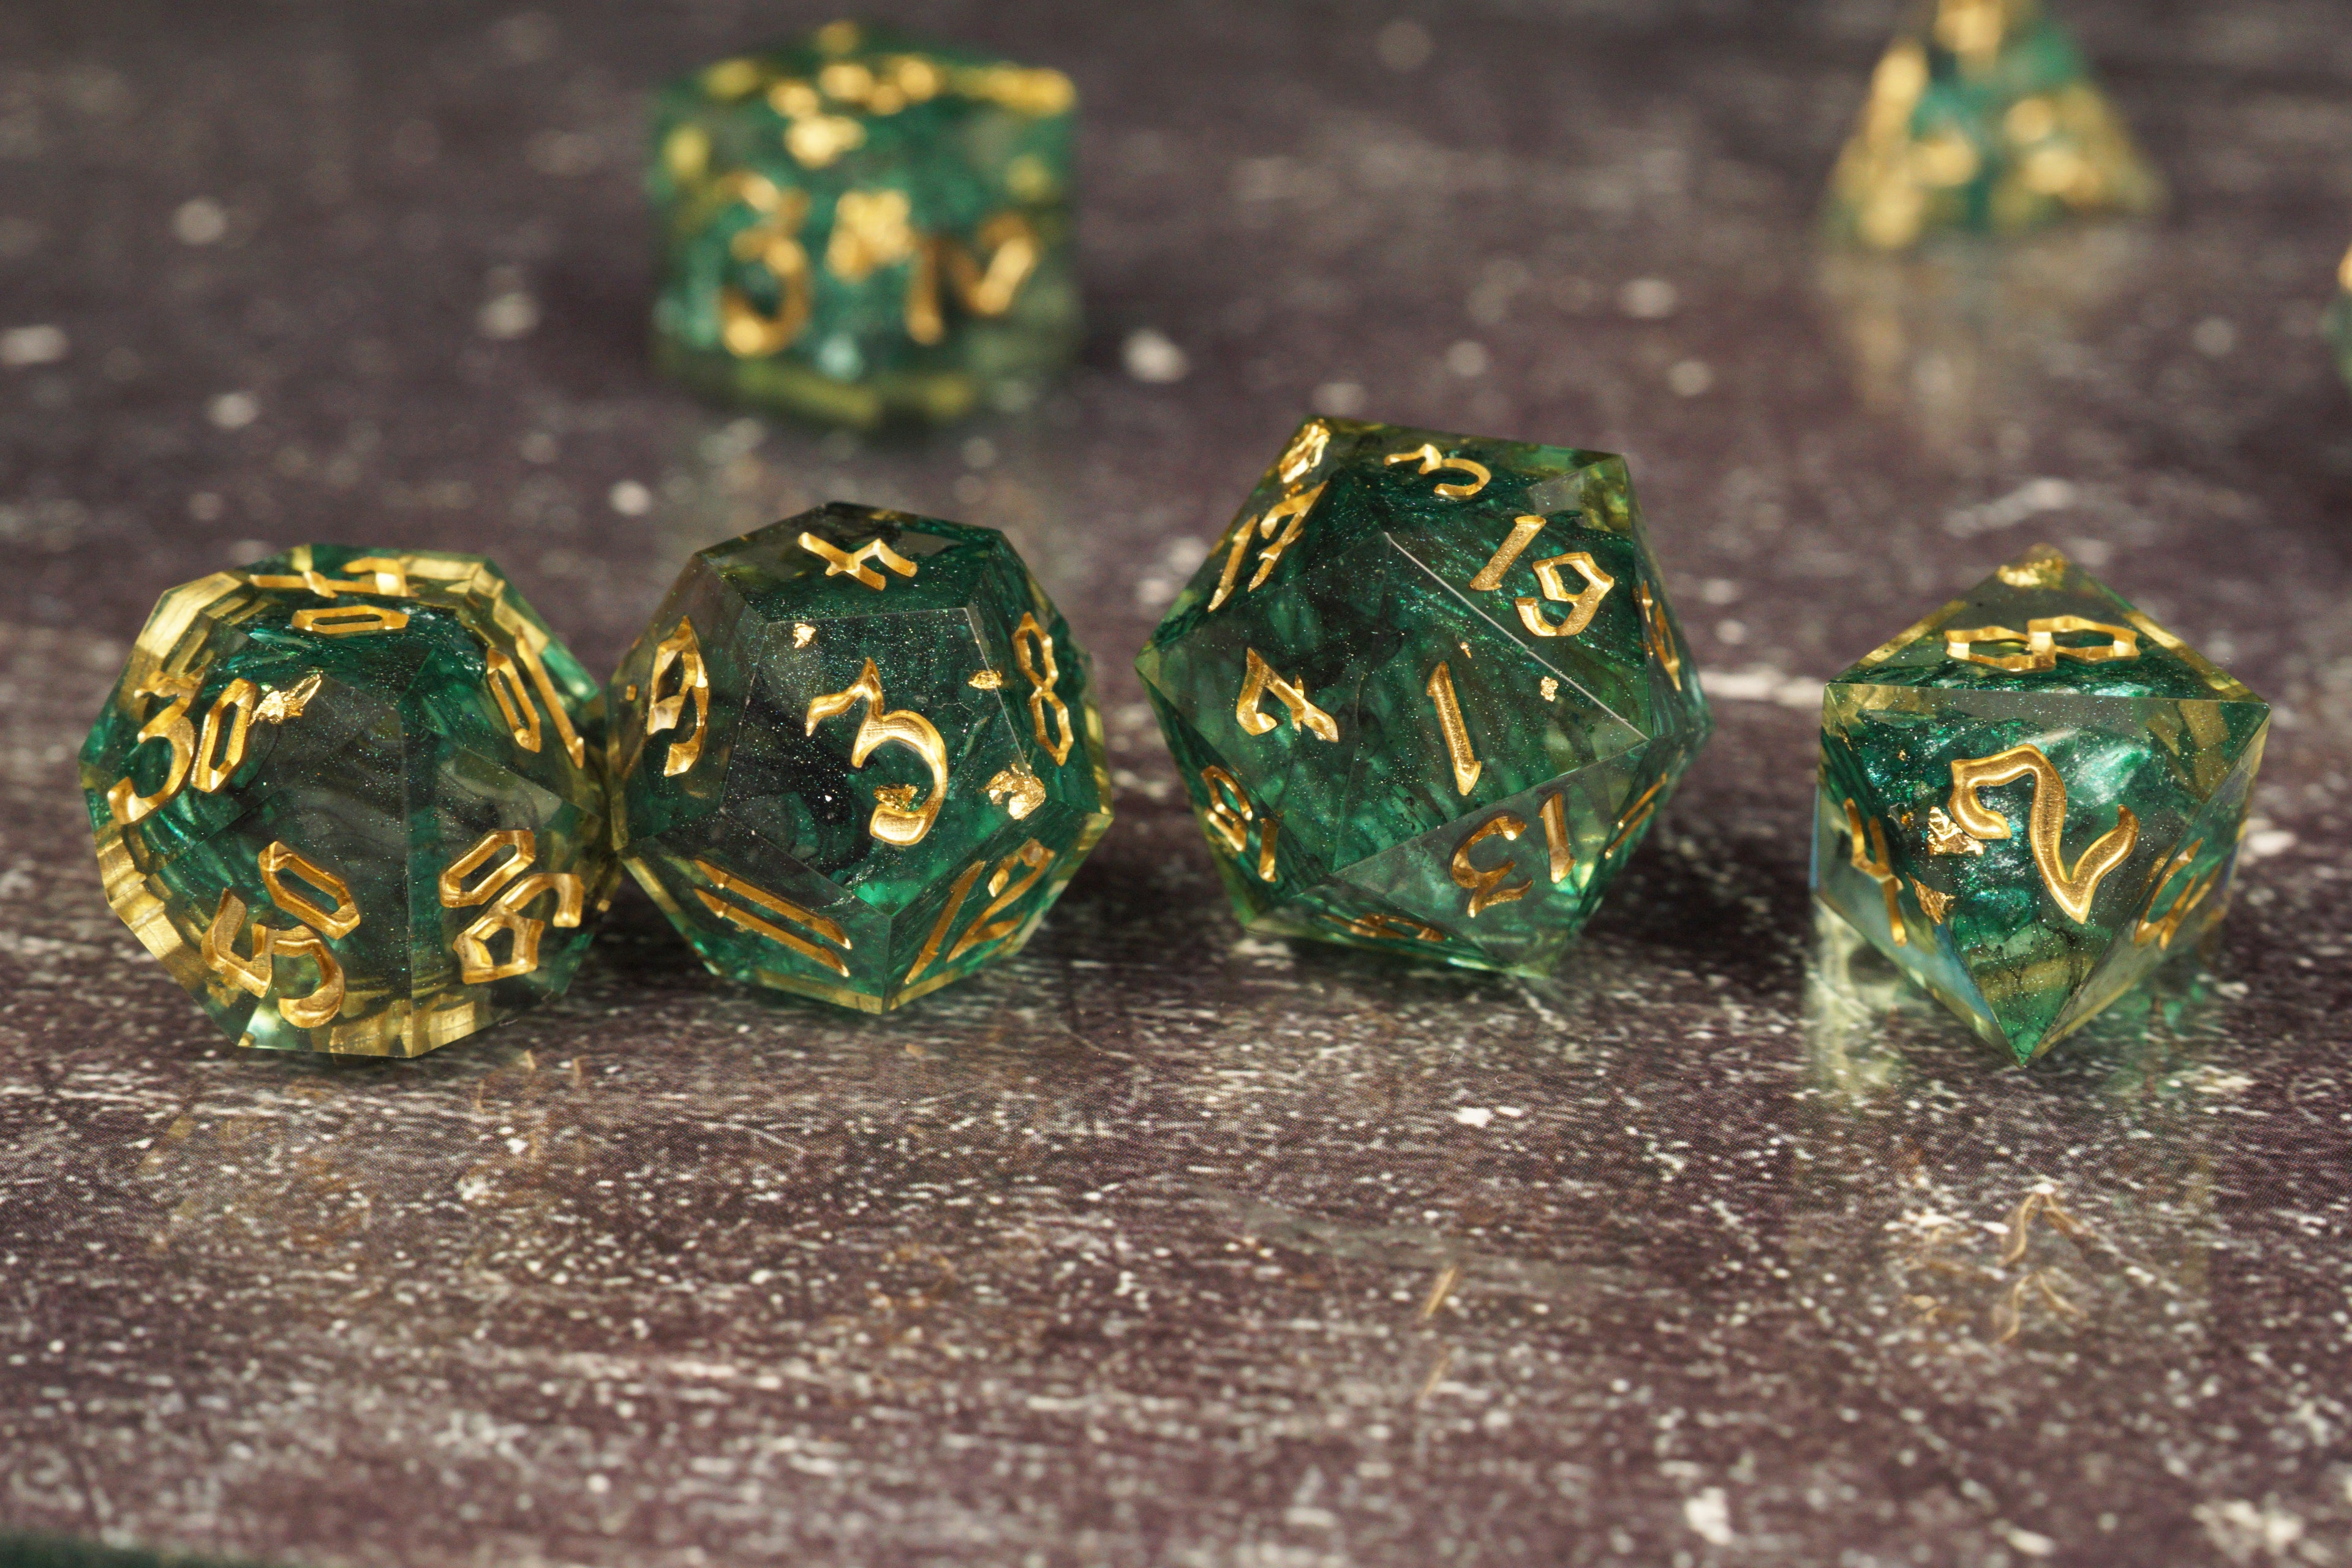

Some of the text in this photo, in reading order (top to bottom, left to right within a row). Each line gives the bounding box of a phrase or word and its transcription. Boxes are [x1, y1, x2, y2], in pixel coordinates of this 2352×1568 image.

[1470, 515, 1614, 637] 19
[1945, 615, 2139, 673] 8
[806, 656, 948, 845] 3
[1012, 612, 1074, 766] 8
[1426, 661, 1481, 796] 1
[1948, 743, 2141, 924] 2
